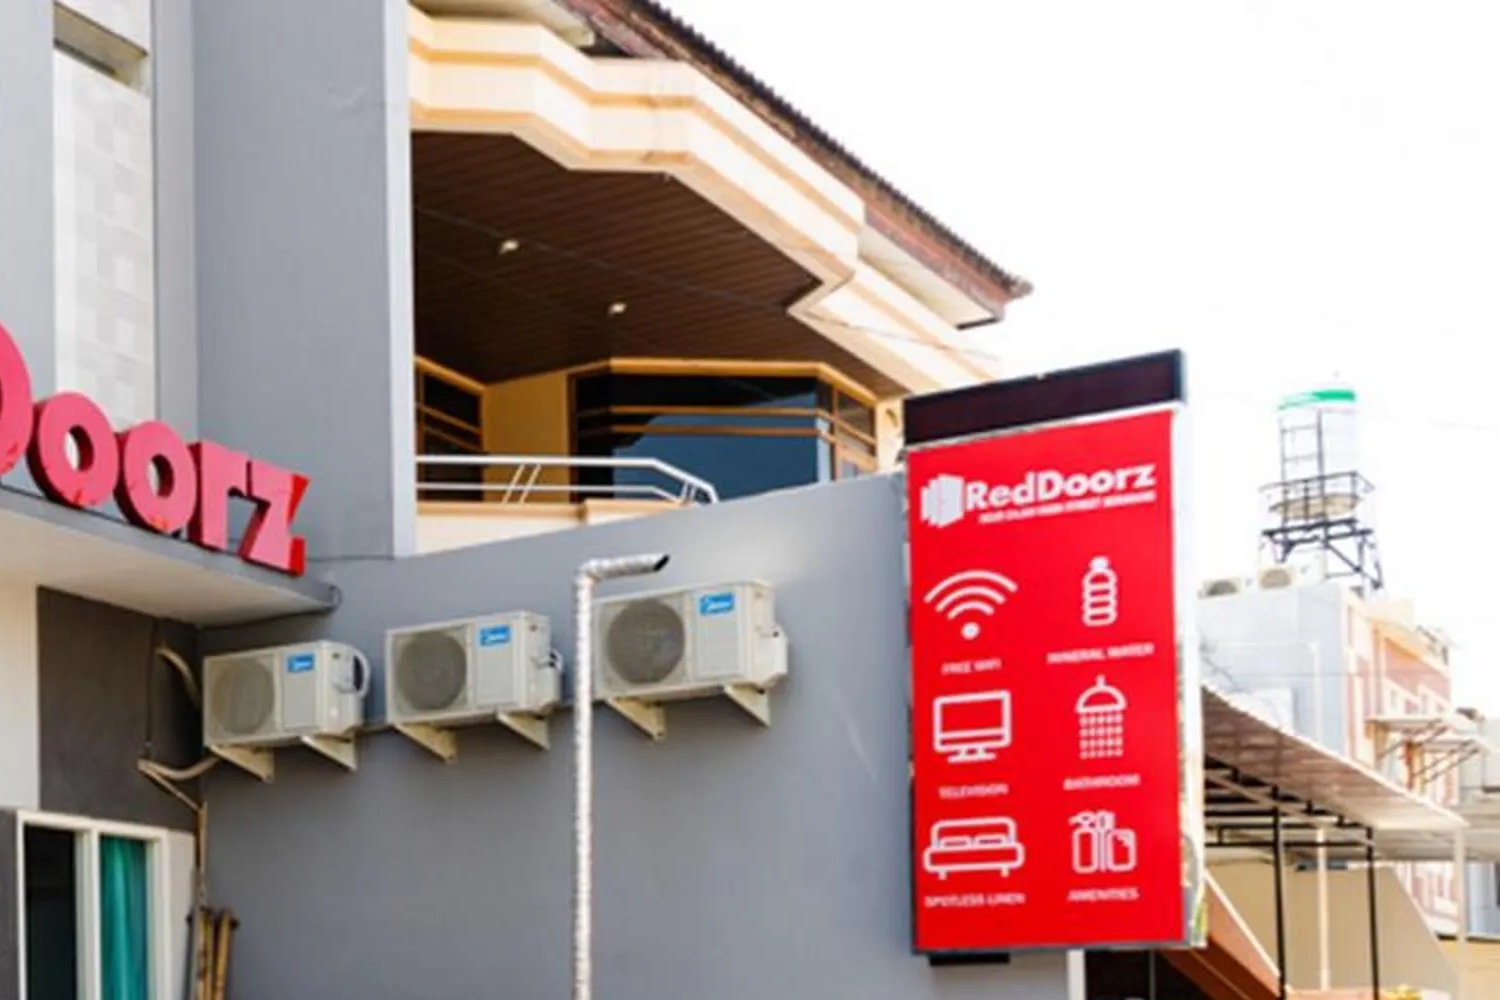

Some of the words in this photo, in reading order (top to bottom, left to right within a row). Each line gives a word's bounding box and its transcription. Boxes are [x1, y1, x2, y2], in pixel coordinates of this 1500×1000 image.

[965, 464, 1156, 512] RedDoorz
[1046, 649, 1106, 664] MINERAL
[1107, 642, 1155, 658] WATER
[937, 783, 1009, 800] TELEVISION
[924, 894, 984, 908] SPOTLESS
[987, 892, 1026, 906] LINEN
